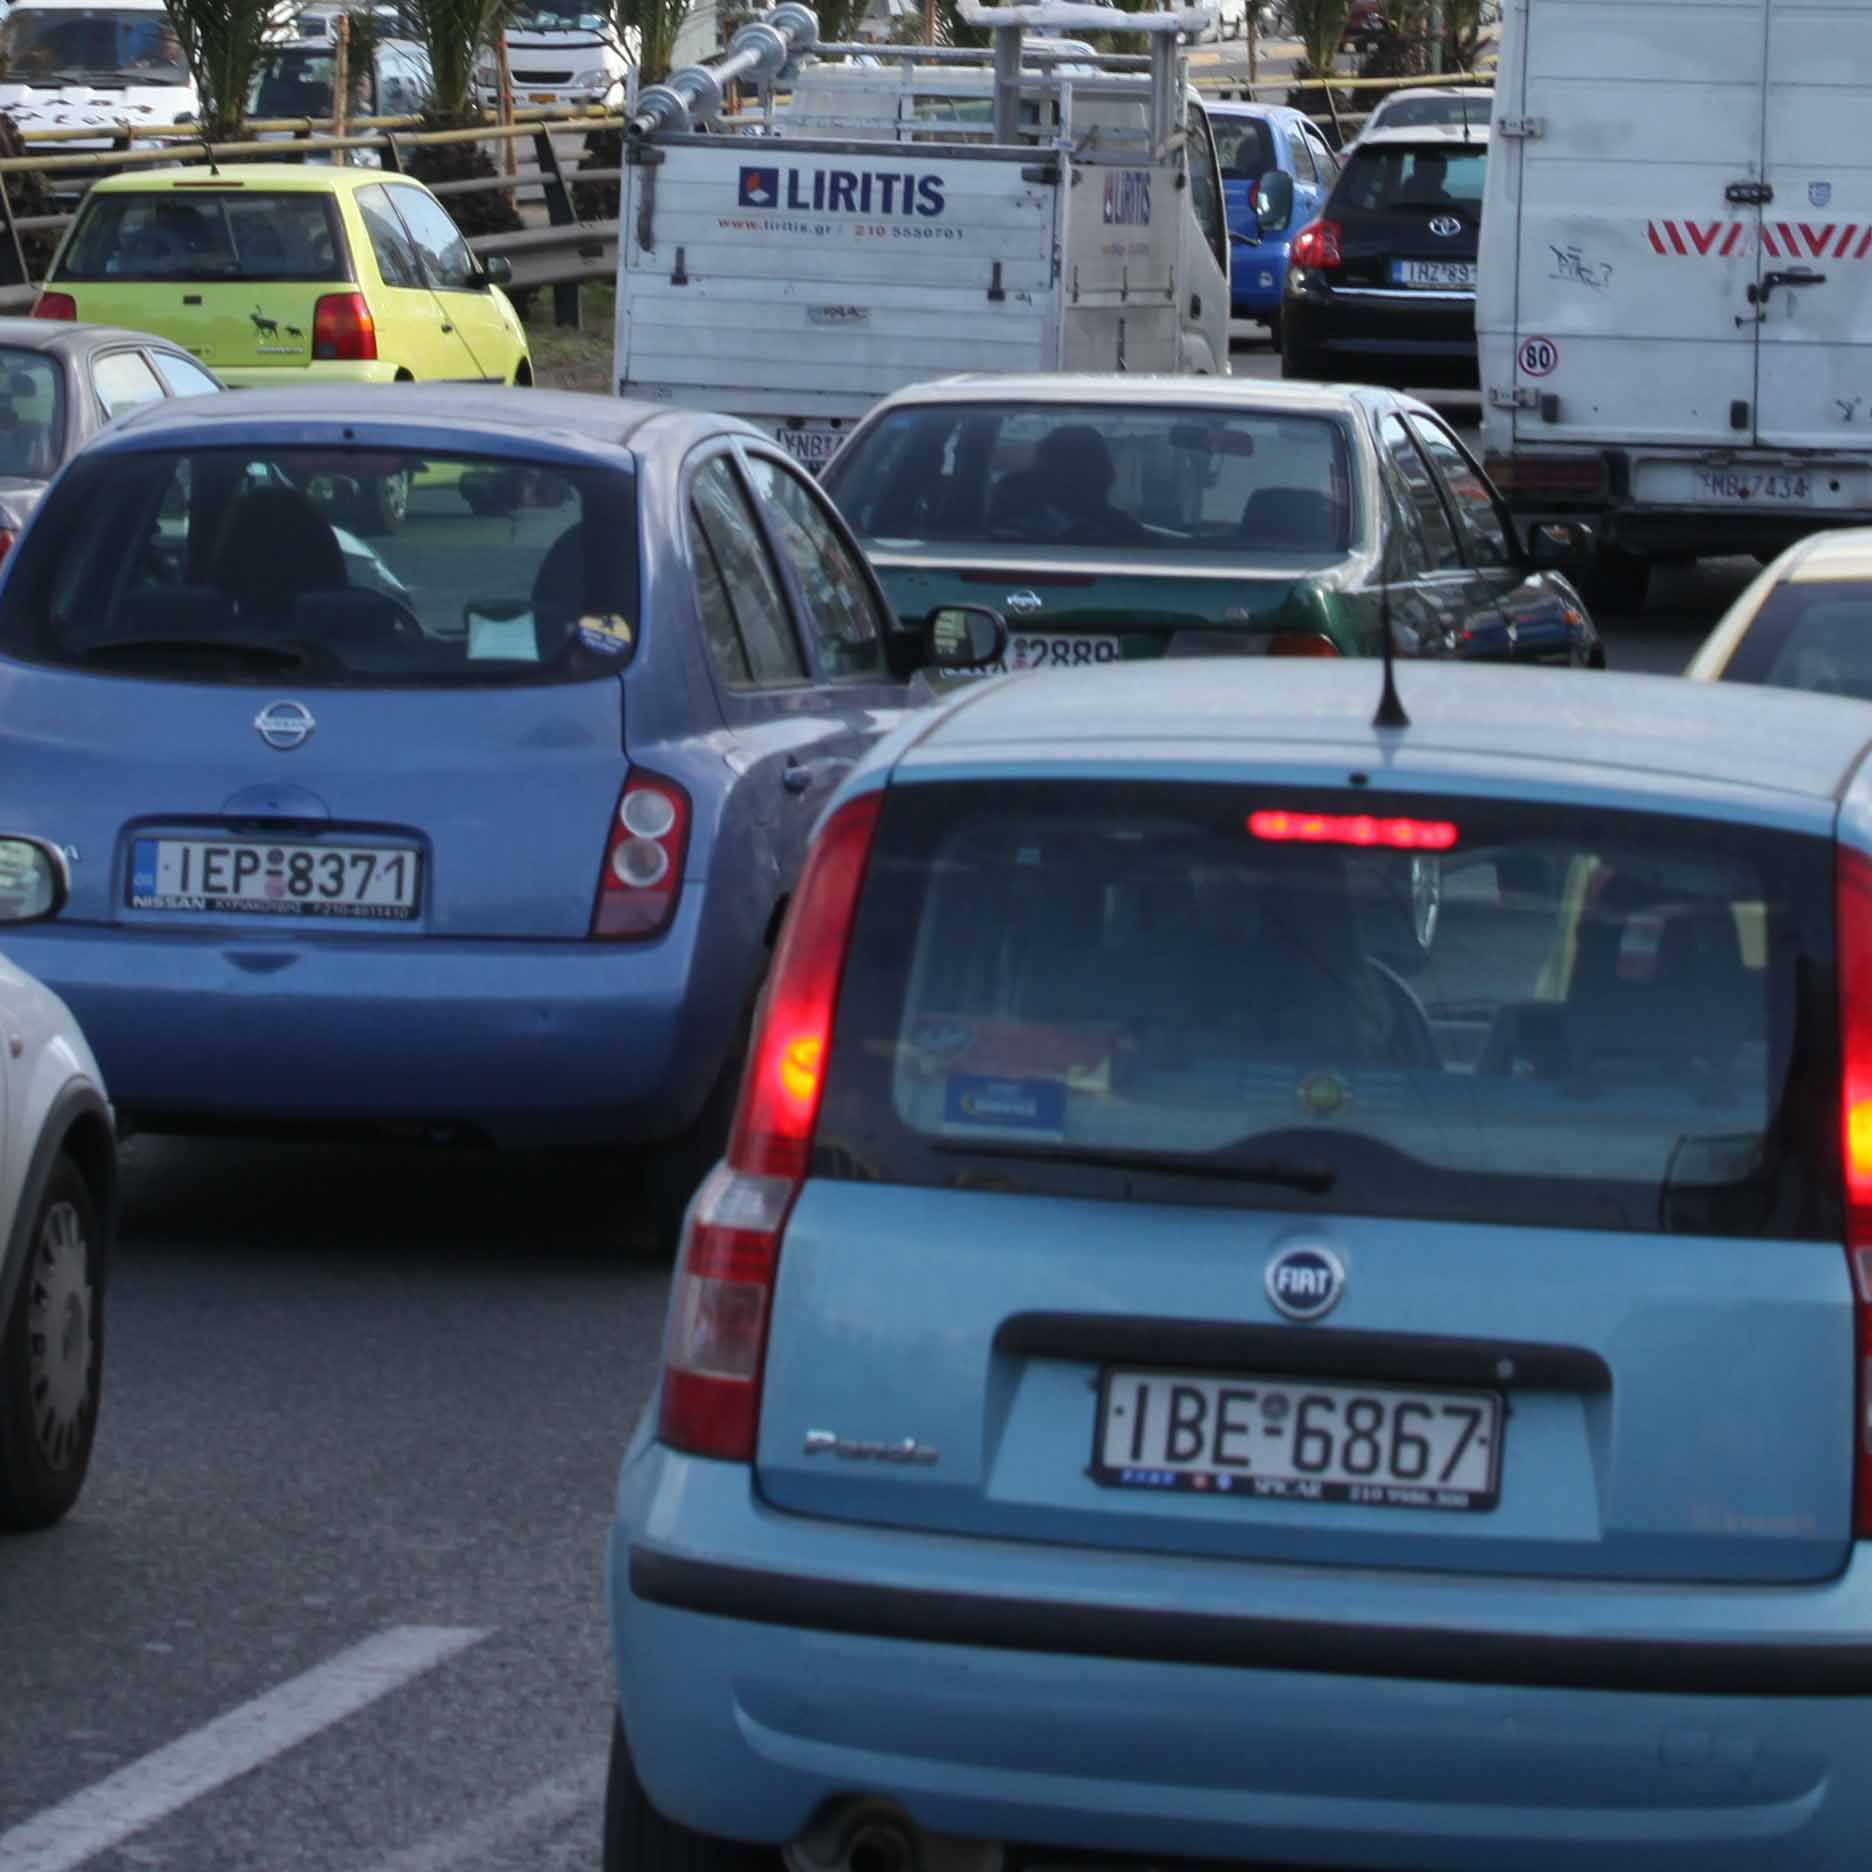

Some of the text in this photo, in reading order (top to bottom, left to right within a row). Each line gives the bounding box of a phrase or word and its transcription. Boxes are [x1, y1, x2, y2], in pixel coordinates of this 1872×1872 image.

[787, 168, 946, 217] LIRITIS
[1526, 344, 1551, 370] 80
[1277, 1265, 1328, 1296] FIAT
